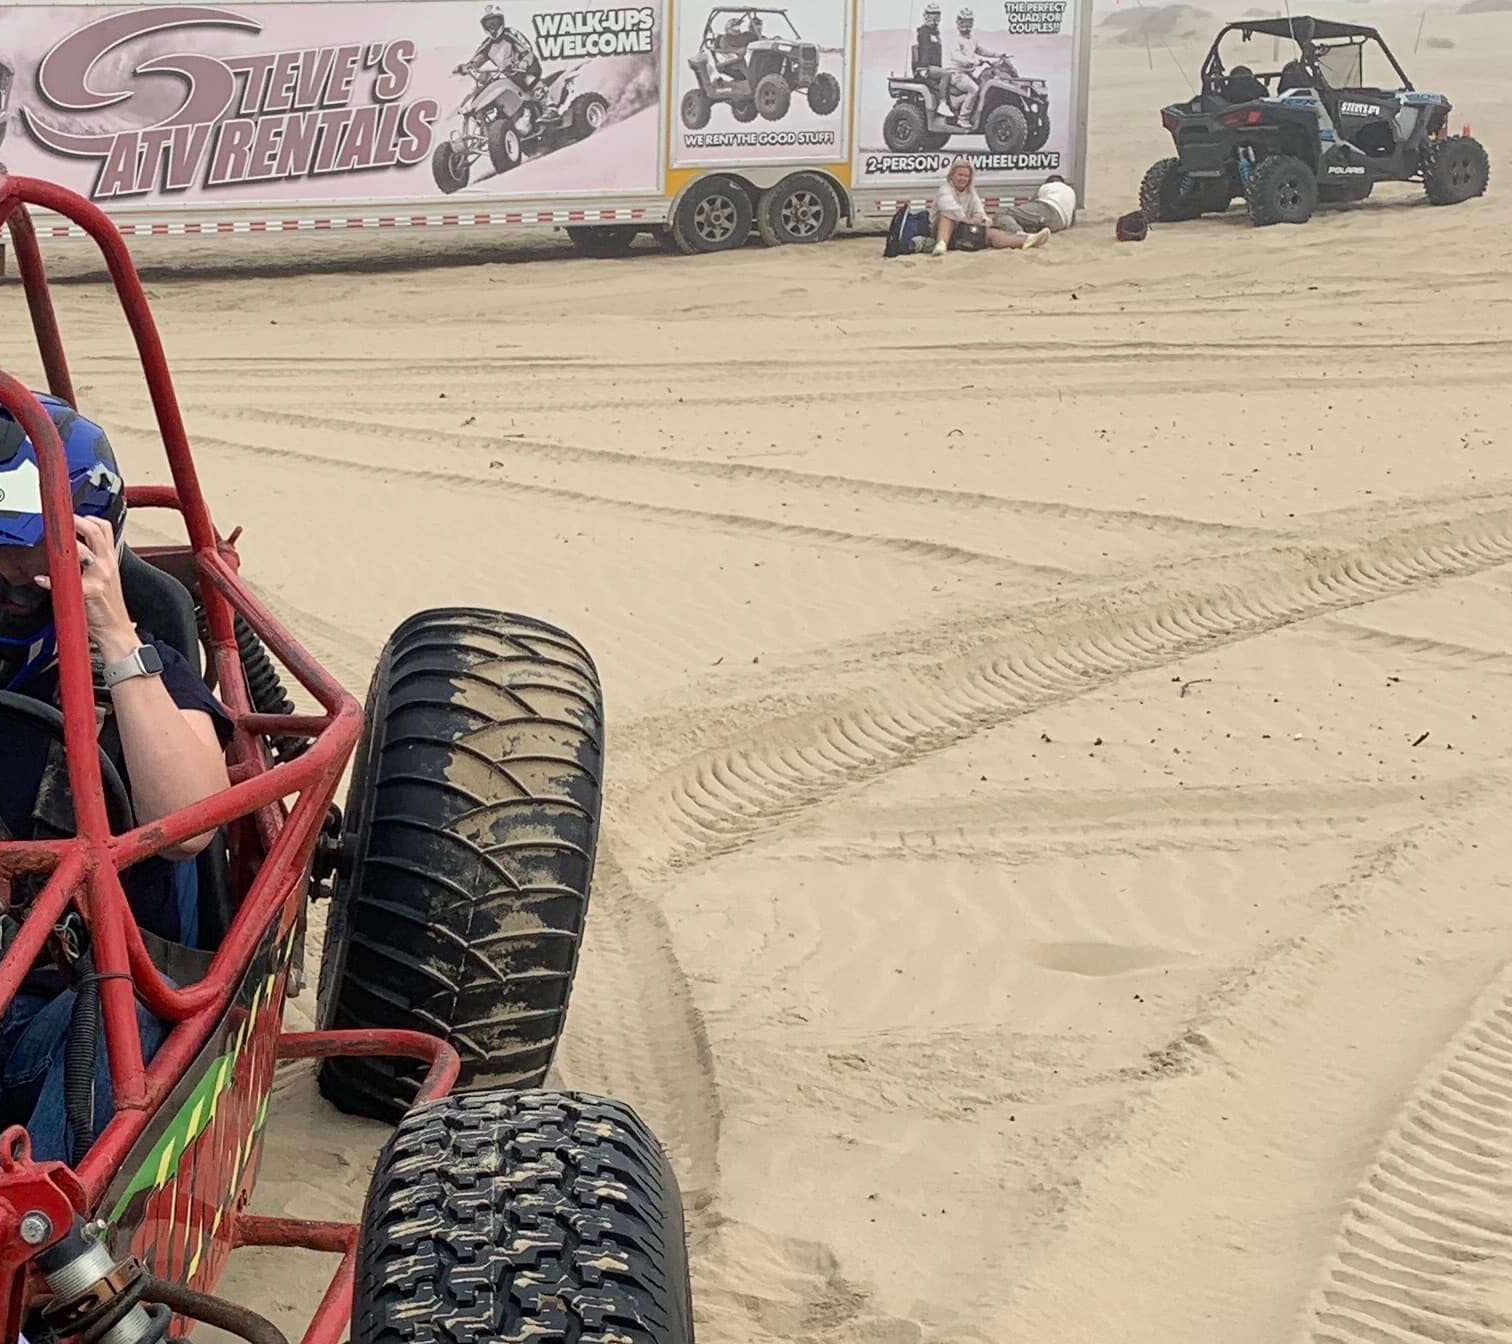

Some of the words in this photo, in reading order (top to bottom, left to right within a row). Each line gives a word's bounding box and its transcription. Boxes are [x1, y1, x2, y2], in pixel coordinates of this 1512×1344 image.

[1005, 1, 1025, 13] THE
[1026, 1, 1067, 13] PERFECT
[533, 7, 654, 36] WALK-UPS
[1008, 12, 1040, 24] QUAD
[1041, 12, 1063, 24] FOR
[536, 30, 652, 60] WELCOME
[684, 134, 704, 147] WE
[704, 133, 737, 147] RENT
[737, 132, 757, 146] THE
[758, 131, 796, 146] GOOD
[797, 130, 836, 145] STUFF!
[91, 119, 215, 199] ATV
[204, 99, 438, 190] RENTALS
[866, 155, 939, 173] 2-PERSON
[1017, 153, 1061, 169] DRIVE
